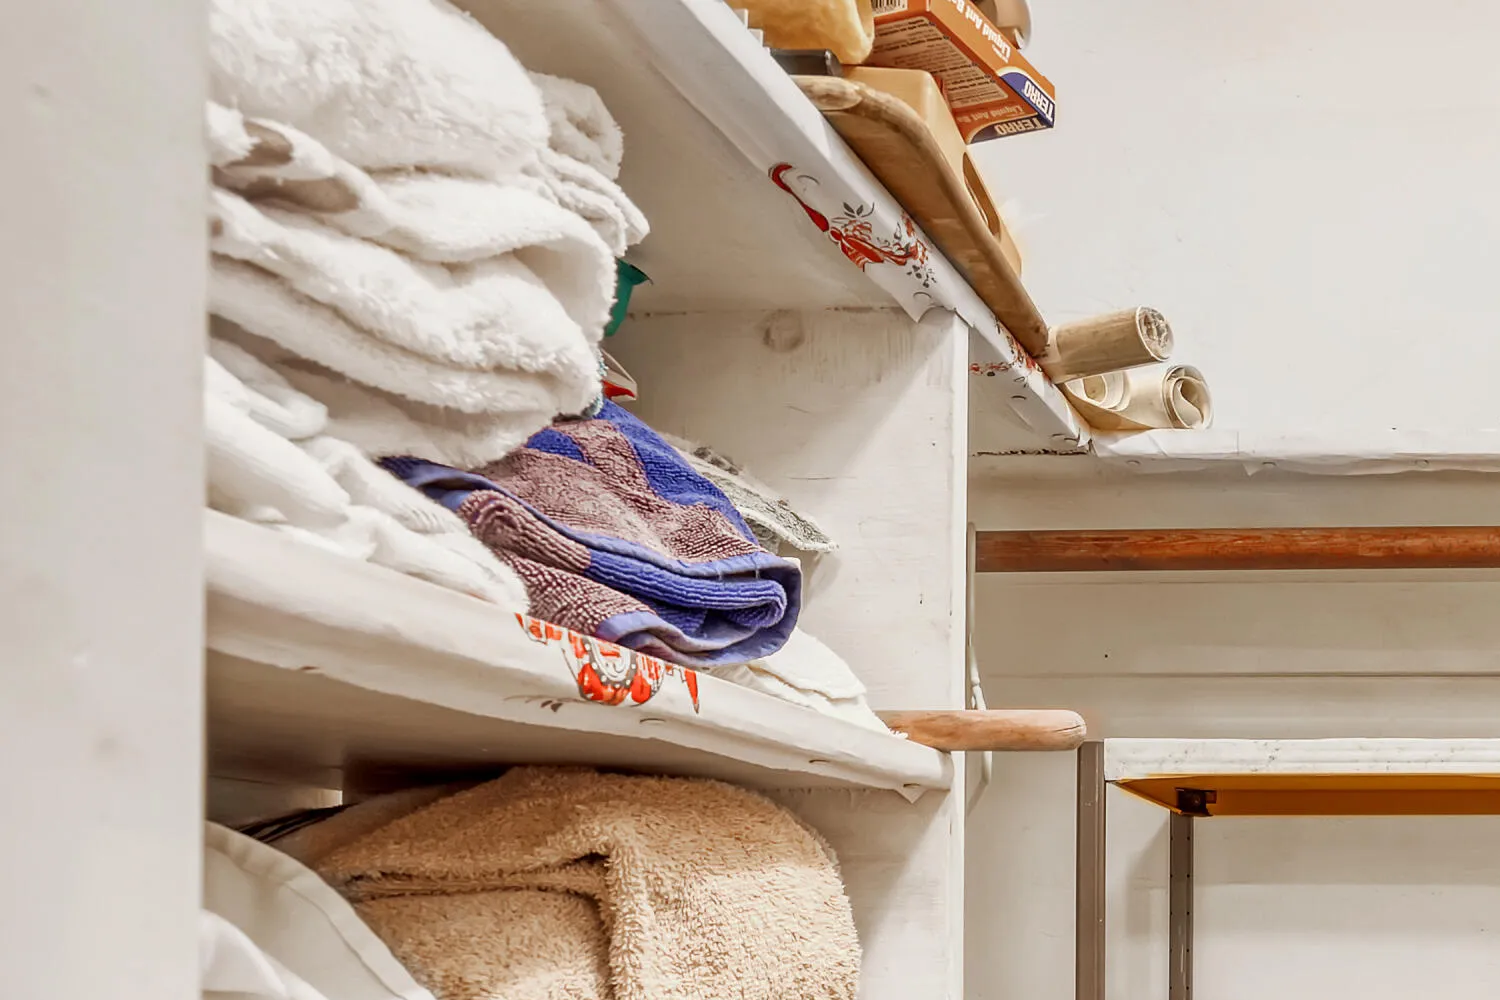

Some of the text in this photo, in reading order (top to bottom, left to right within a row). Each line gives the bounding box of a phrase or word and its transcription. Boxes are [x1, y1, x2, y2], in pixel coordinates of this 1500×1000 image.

[965, 10, 983, 29] Ant
[981, 23, 1011, 60] Liquid
[1023, 80, 1054, 122] TERRO
[994, 117, 1046, 135] TERRO
